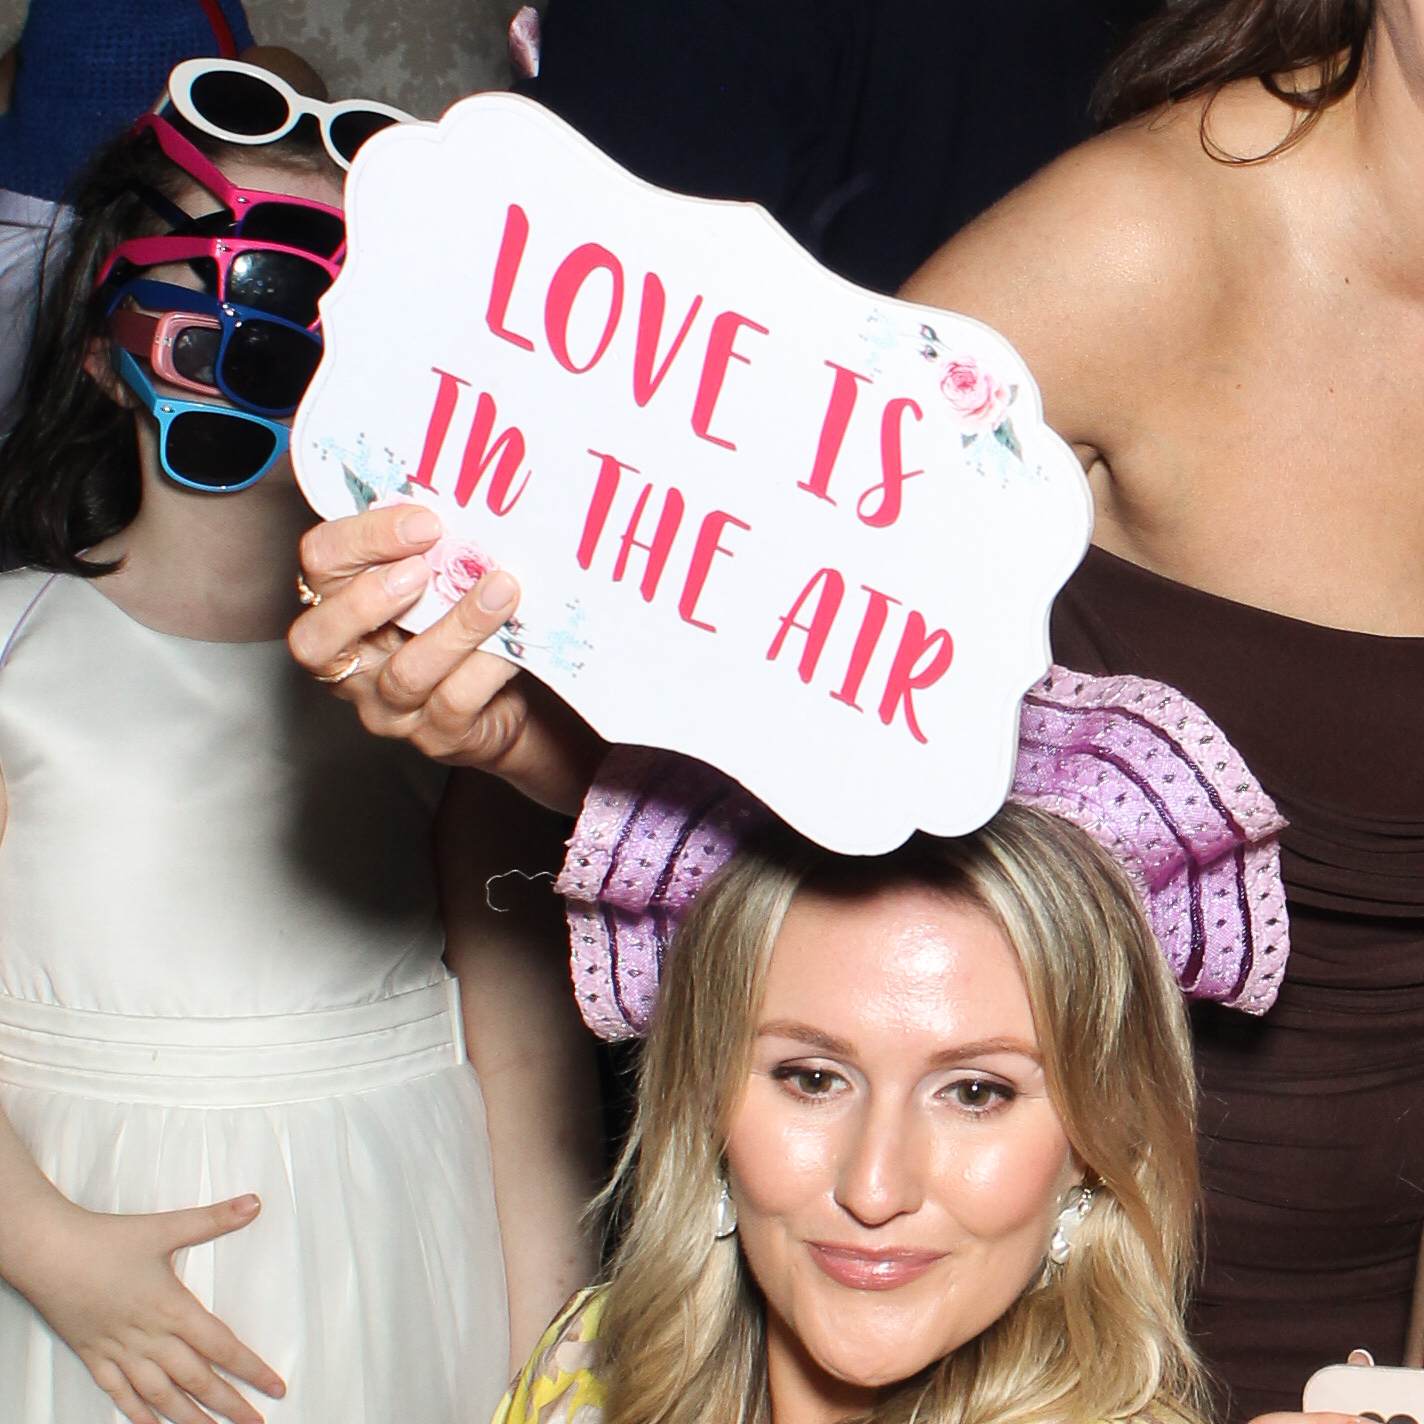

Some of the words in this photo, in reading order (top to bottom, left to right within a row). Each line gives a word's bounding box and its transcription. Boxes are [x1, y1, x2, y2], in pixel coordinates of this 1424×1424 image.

[485, 203, 770, 452] LOVE
[796, 360, 924, 529] IS
[576, 448, 752, 634] THE
[766, 567, 955, 745] AIR
